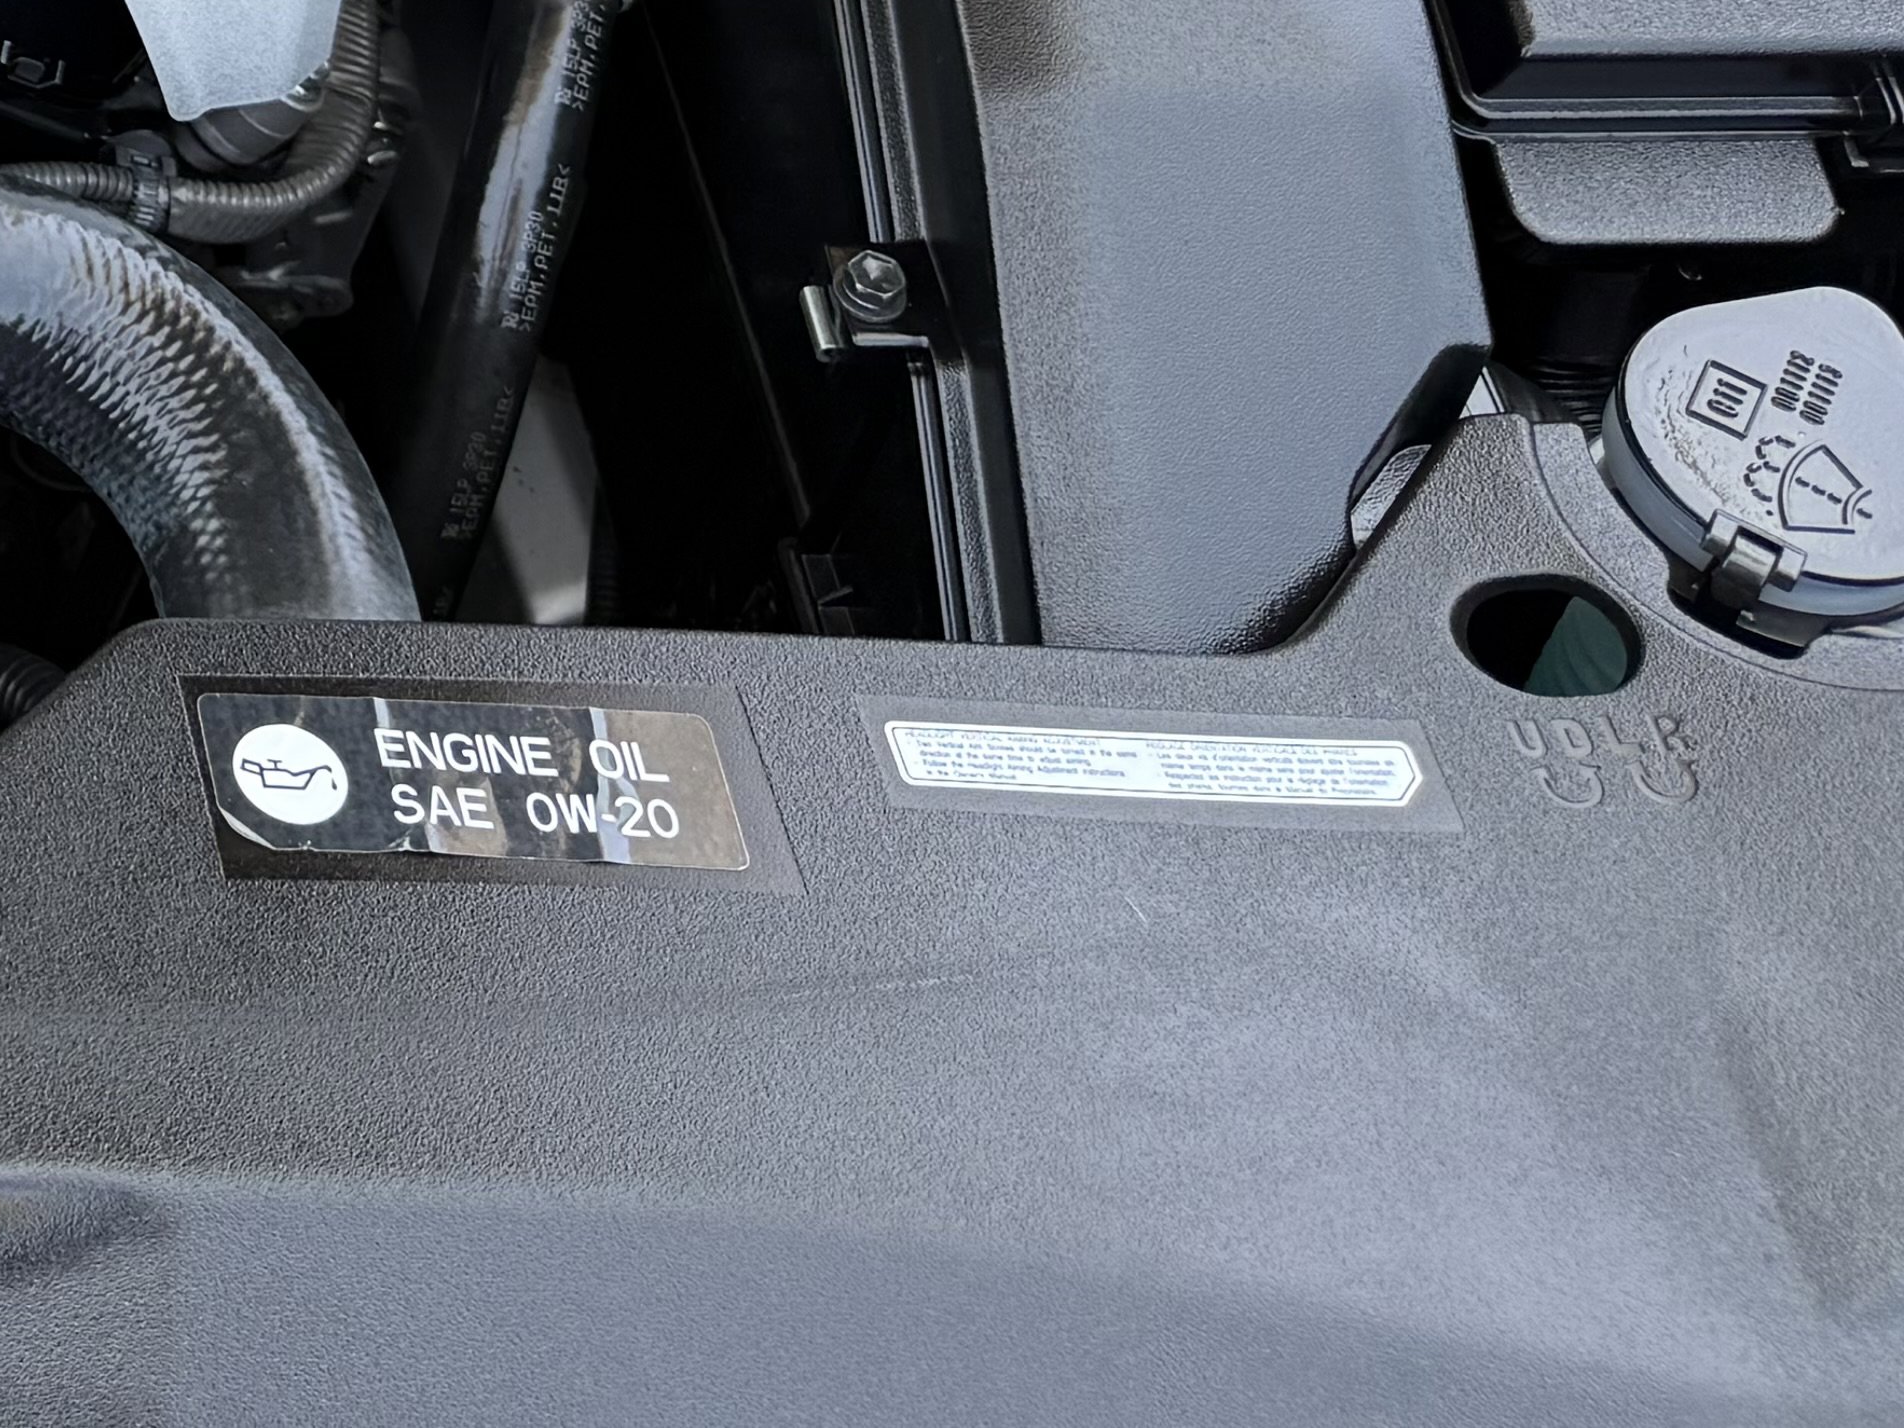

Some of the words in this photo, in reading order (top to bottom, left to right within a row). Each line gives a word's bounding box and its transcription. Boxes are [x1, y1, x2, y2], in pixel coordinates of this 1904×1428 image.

[373, 728, 559, 777] ENGINE
[588, 738, 671, 783] OIL
[391, 783, 494, 830] SAE
[525, 792, 681, 840] 0W-20
